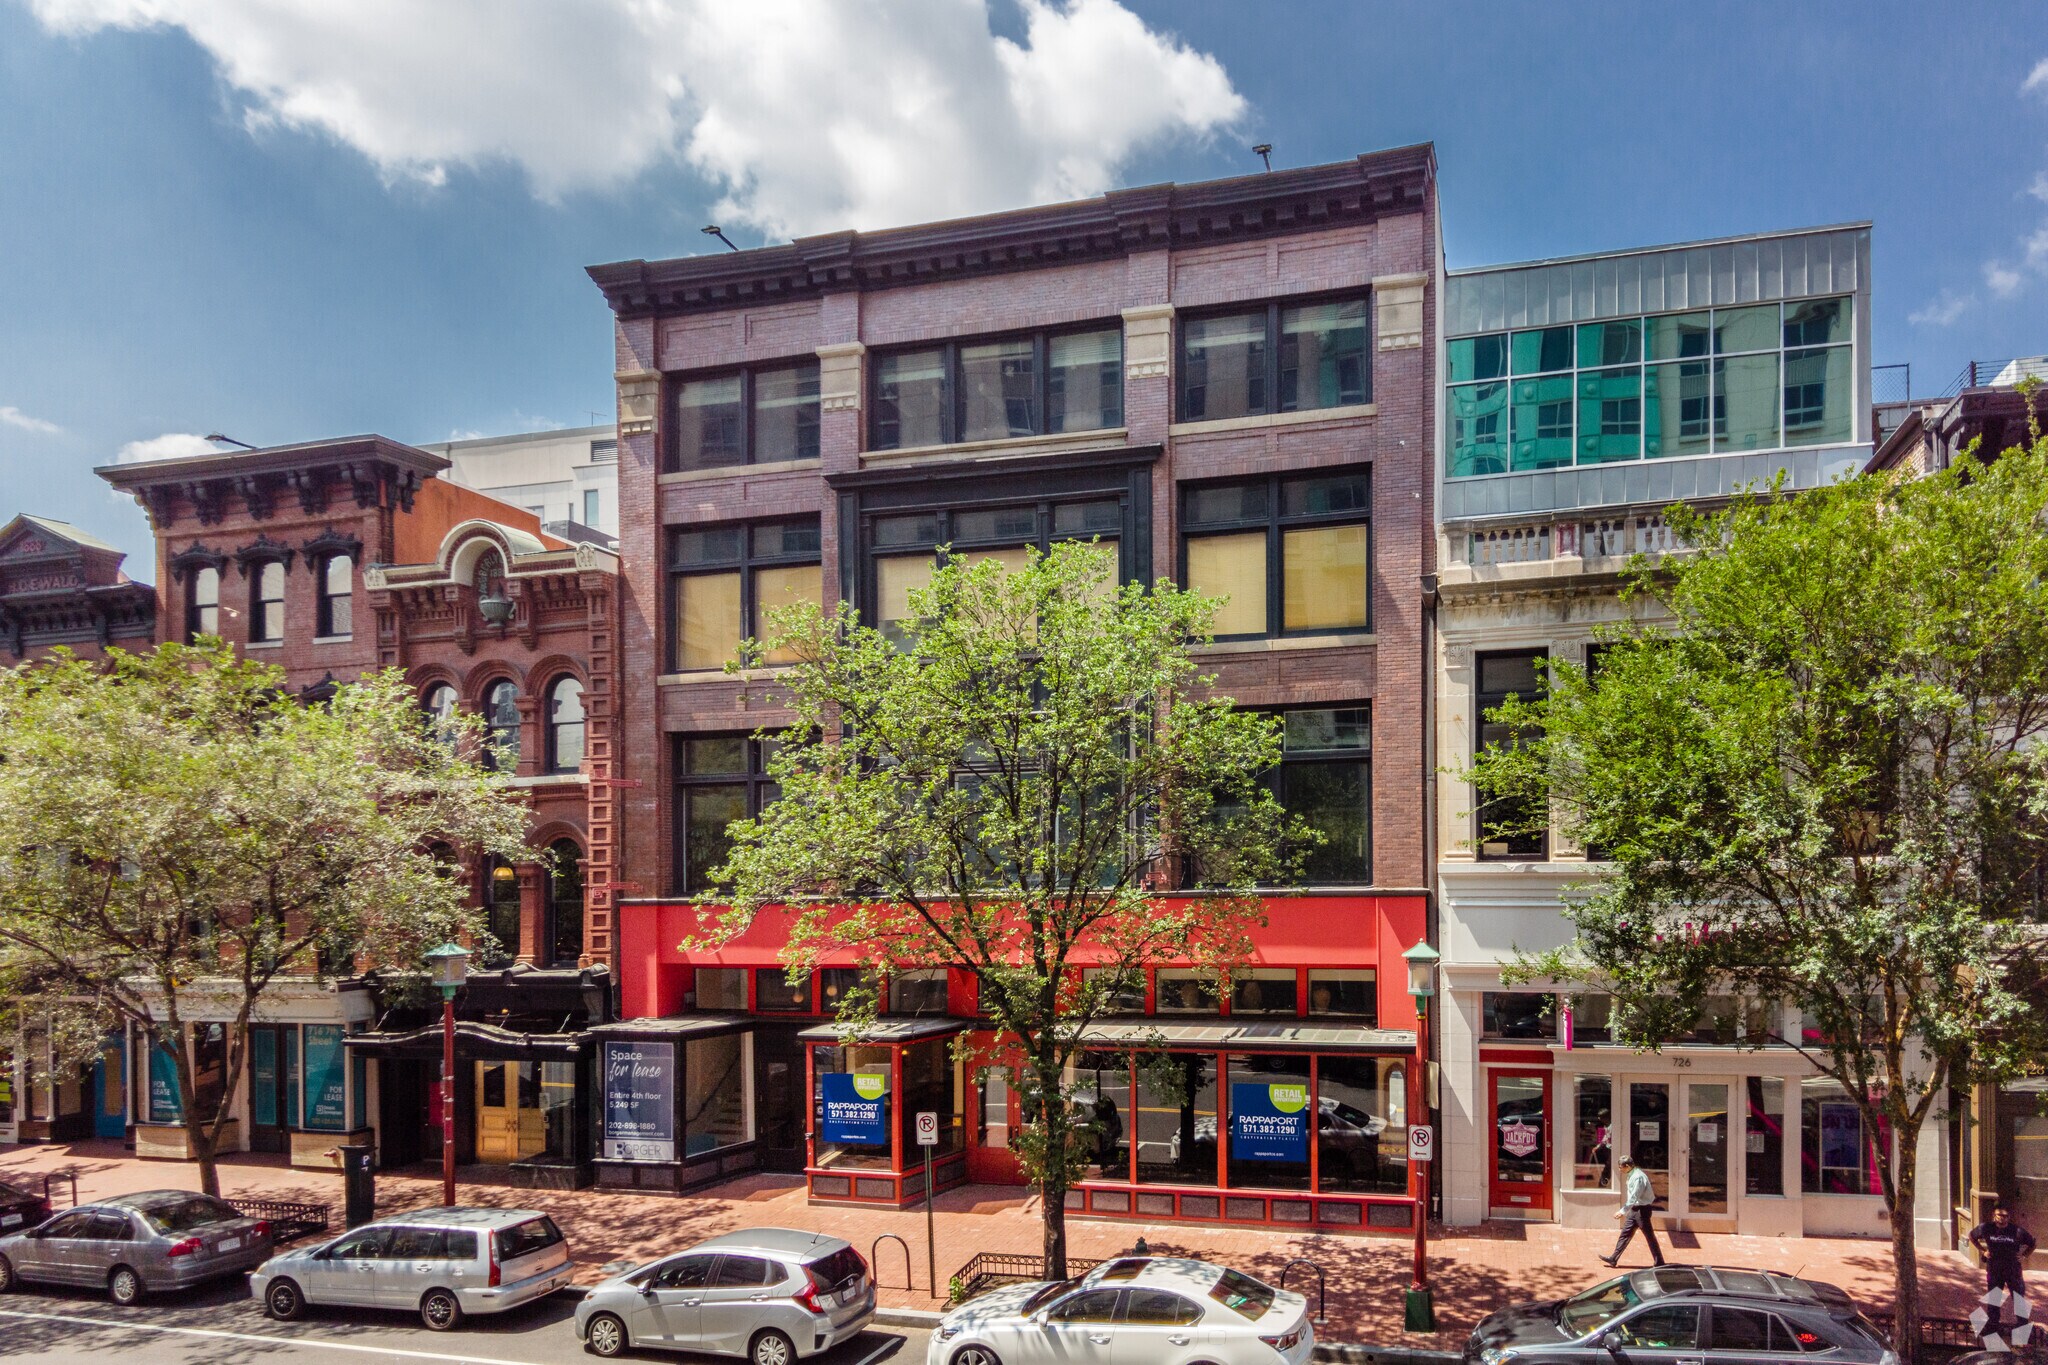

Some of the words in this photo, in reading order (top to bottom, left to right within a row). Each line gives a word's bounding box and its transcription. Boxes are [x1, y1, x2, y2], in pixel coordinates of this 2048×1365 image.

[611, 1050, 642, 1062] Space
[1673, 1058, 1692, 1067] 726
[609, 1061, 629, 1082] for
[632, 1062, 662, 1078] lease
[858, 1078, 881, 1086] RETAIL
[645, 1092, 662, 1100] floor
[1274, 1089, 1302, 1098] RETAIL
[828, 1102, 879, 1111] RAPPAPORT
[831, 1110, 876, 1119] 571.382.1290
[1239, 1116, 1300, 1125] RAPPAPORT
[609, 1122, 656, 1130] 202-898-1880
[1243, 1125, 1296, 1134] 571.382.1290
[1506, 1131, 1535, 1144] JACKPOT
